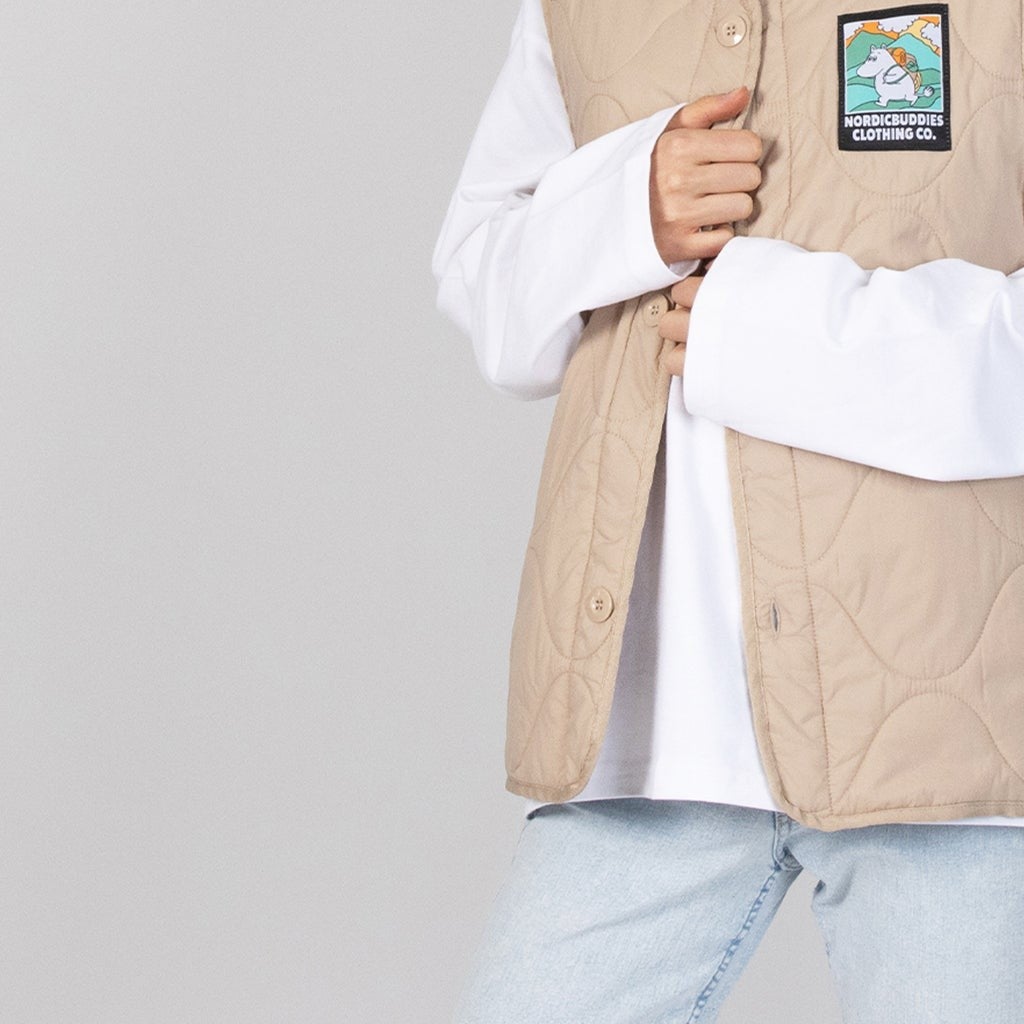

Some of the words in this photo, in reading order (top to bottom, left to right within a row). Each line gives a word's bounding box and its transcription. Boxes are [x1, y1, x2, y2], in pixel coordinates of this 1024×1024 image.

[844, 113, 944, 127] NORDICBUDDIES
[852, 128, 914, 141] CLOTHING
[916, 127, 937, 140] CO.
